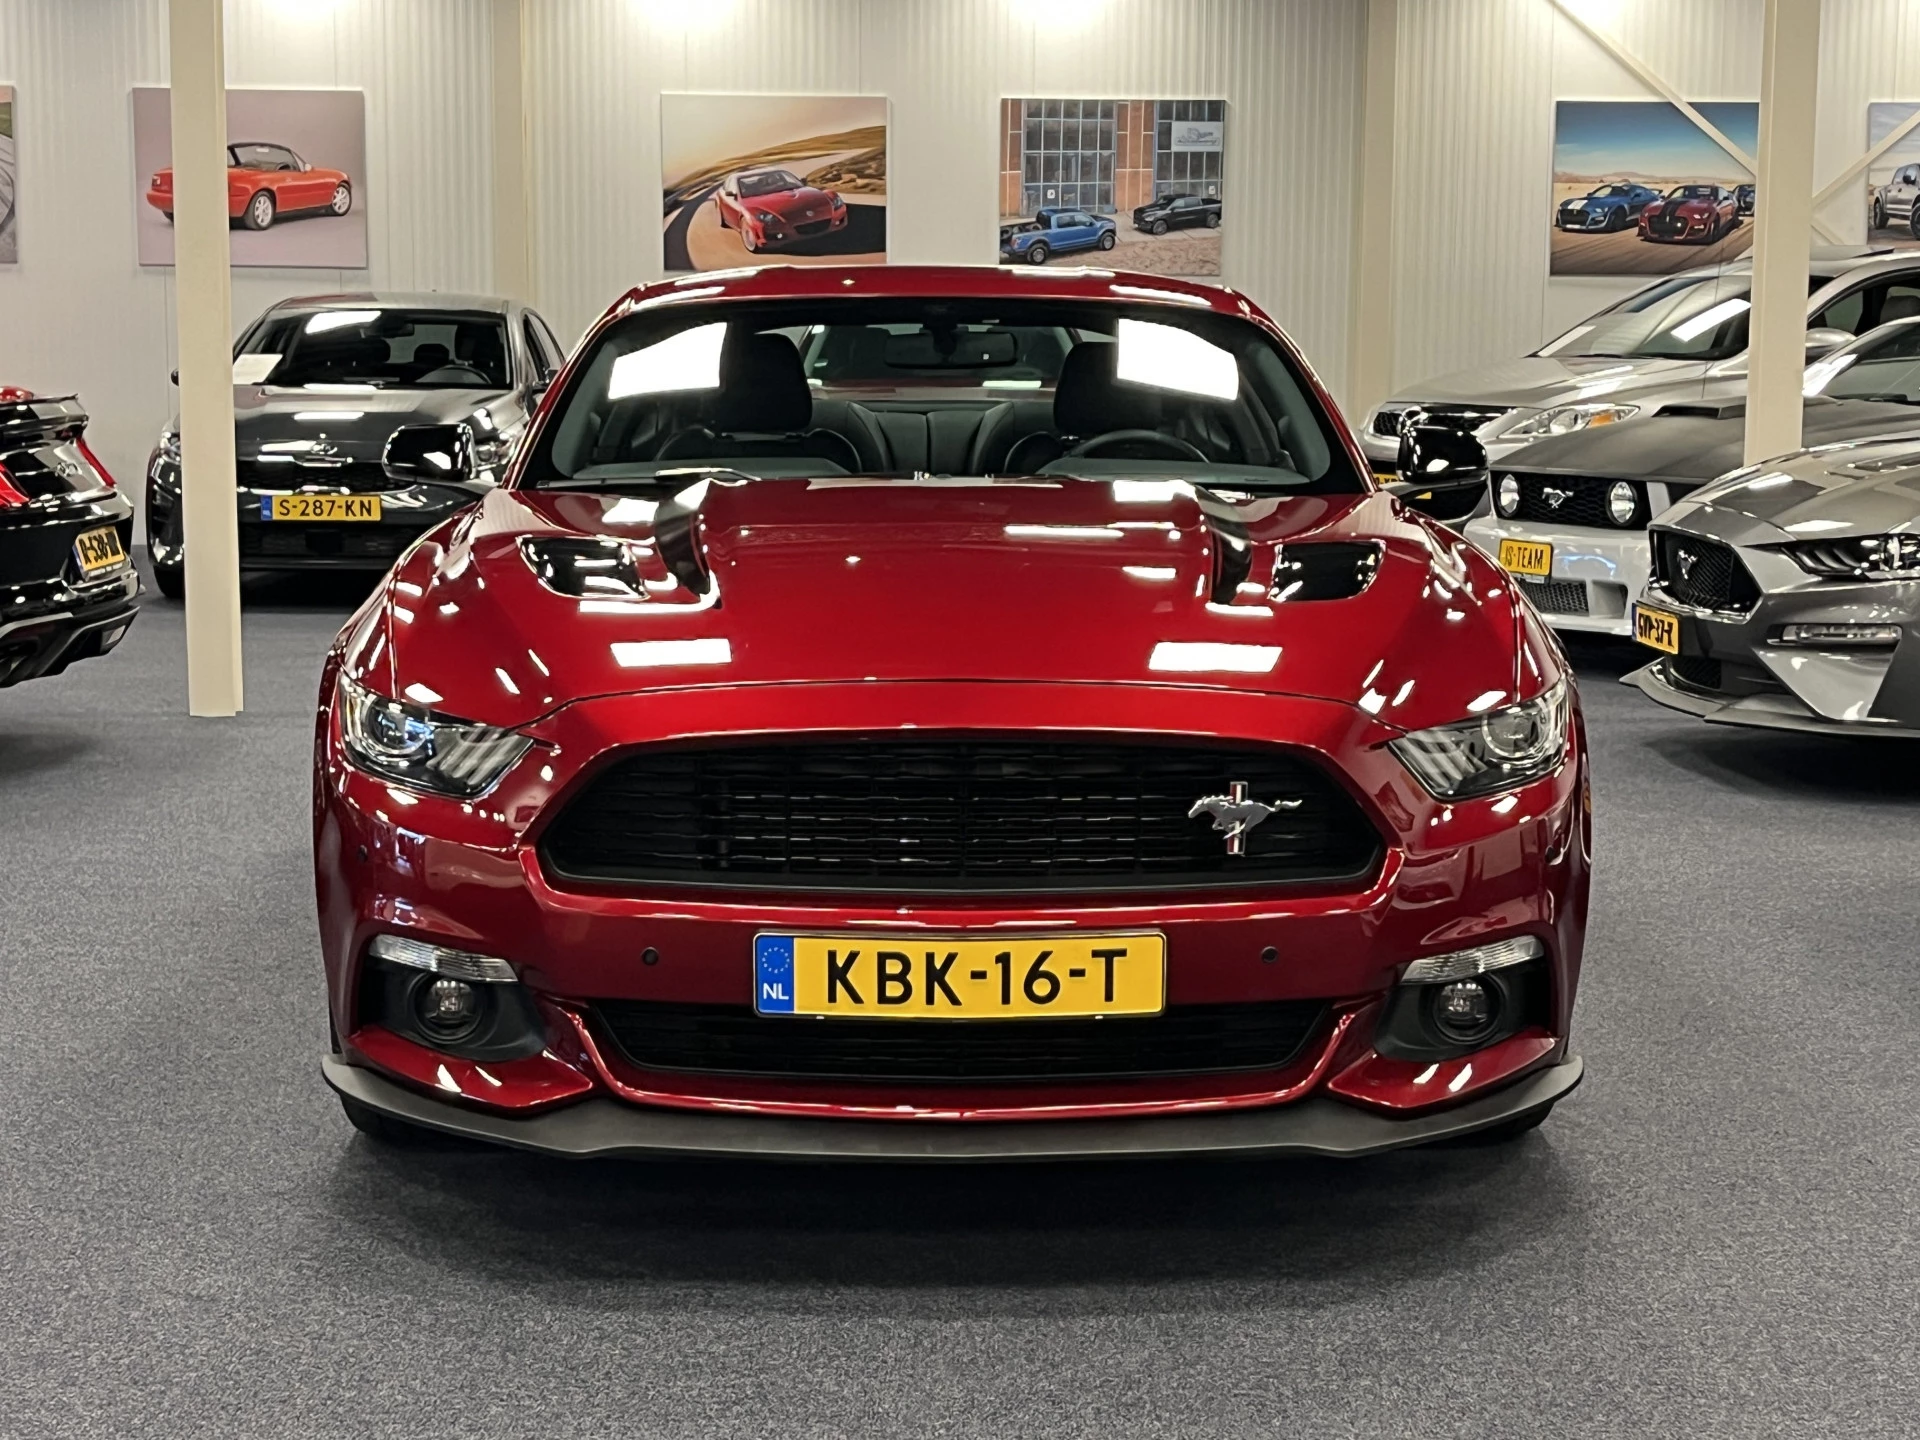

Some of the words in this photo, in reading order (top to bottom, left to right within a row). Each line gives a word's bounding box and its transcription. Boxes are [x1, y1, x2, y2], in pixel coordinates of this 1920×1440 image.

[279, 499, 372, 517] S-287-KN
[827, 947, 1128, 1007] KBK-16-T
[763, 982, 789, 1000] NL
